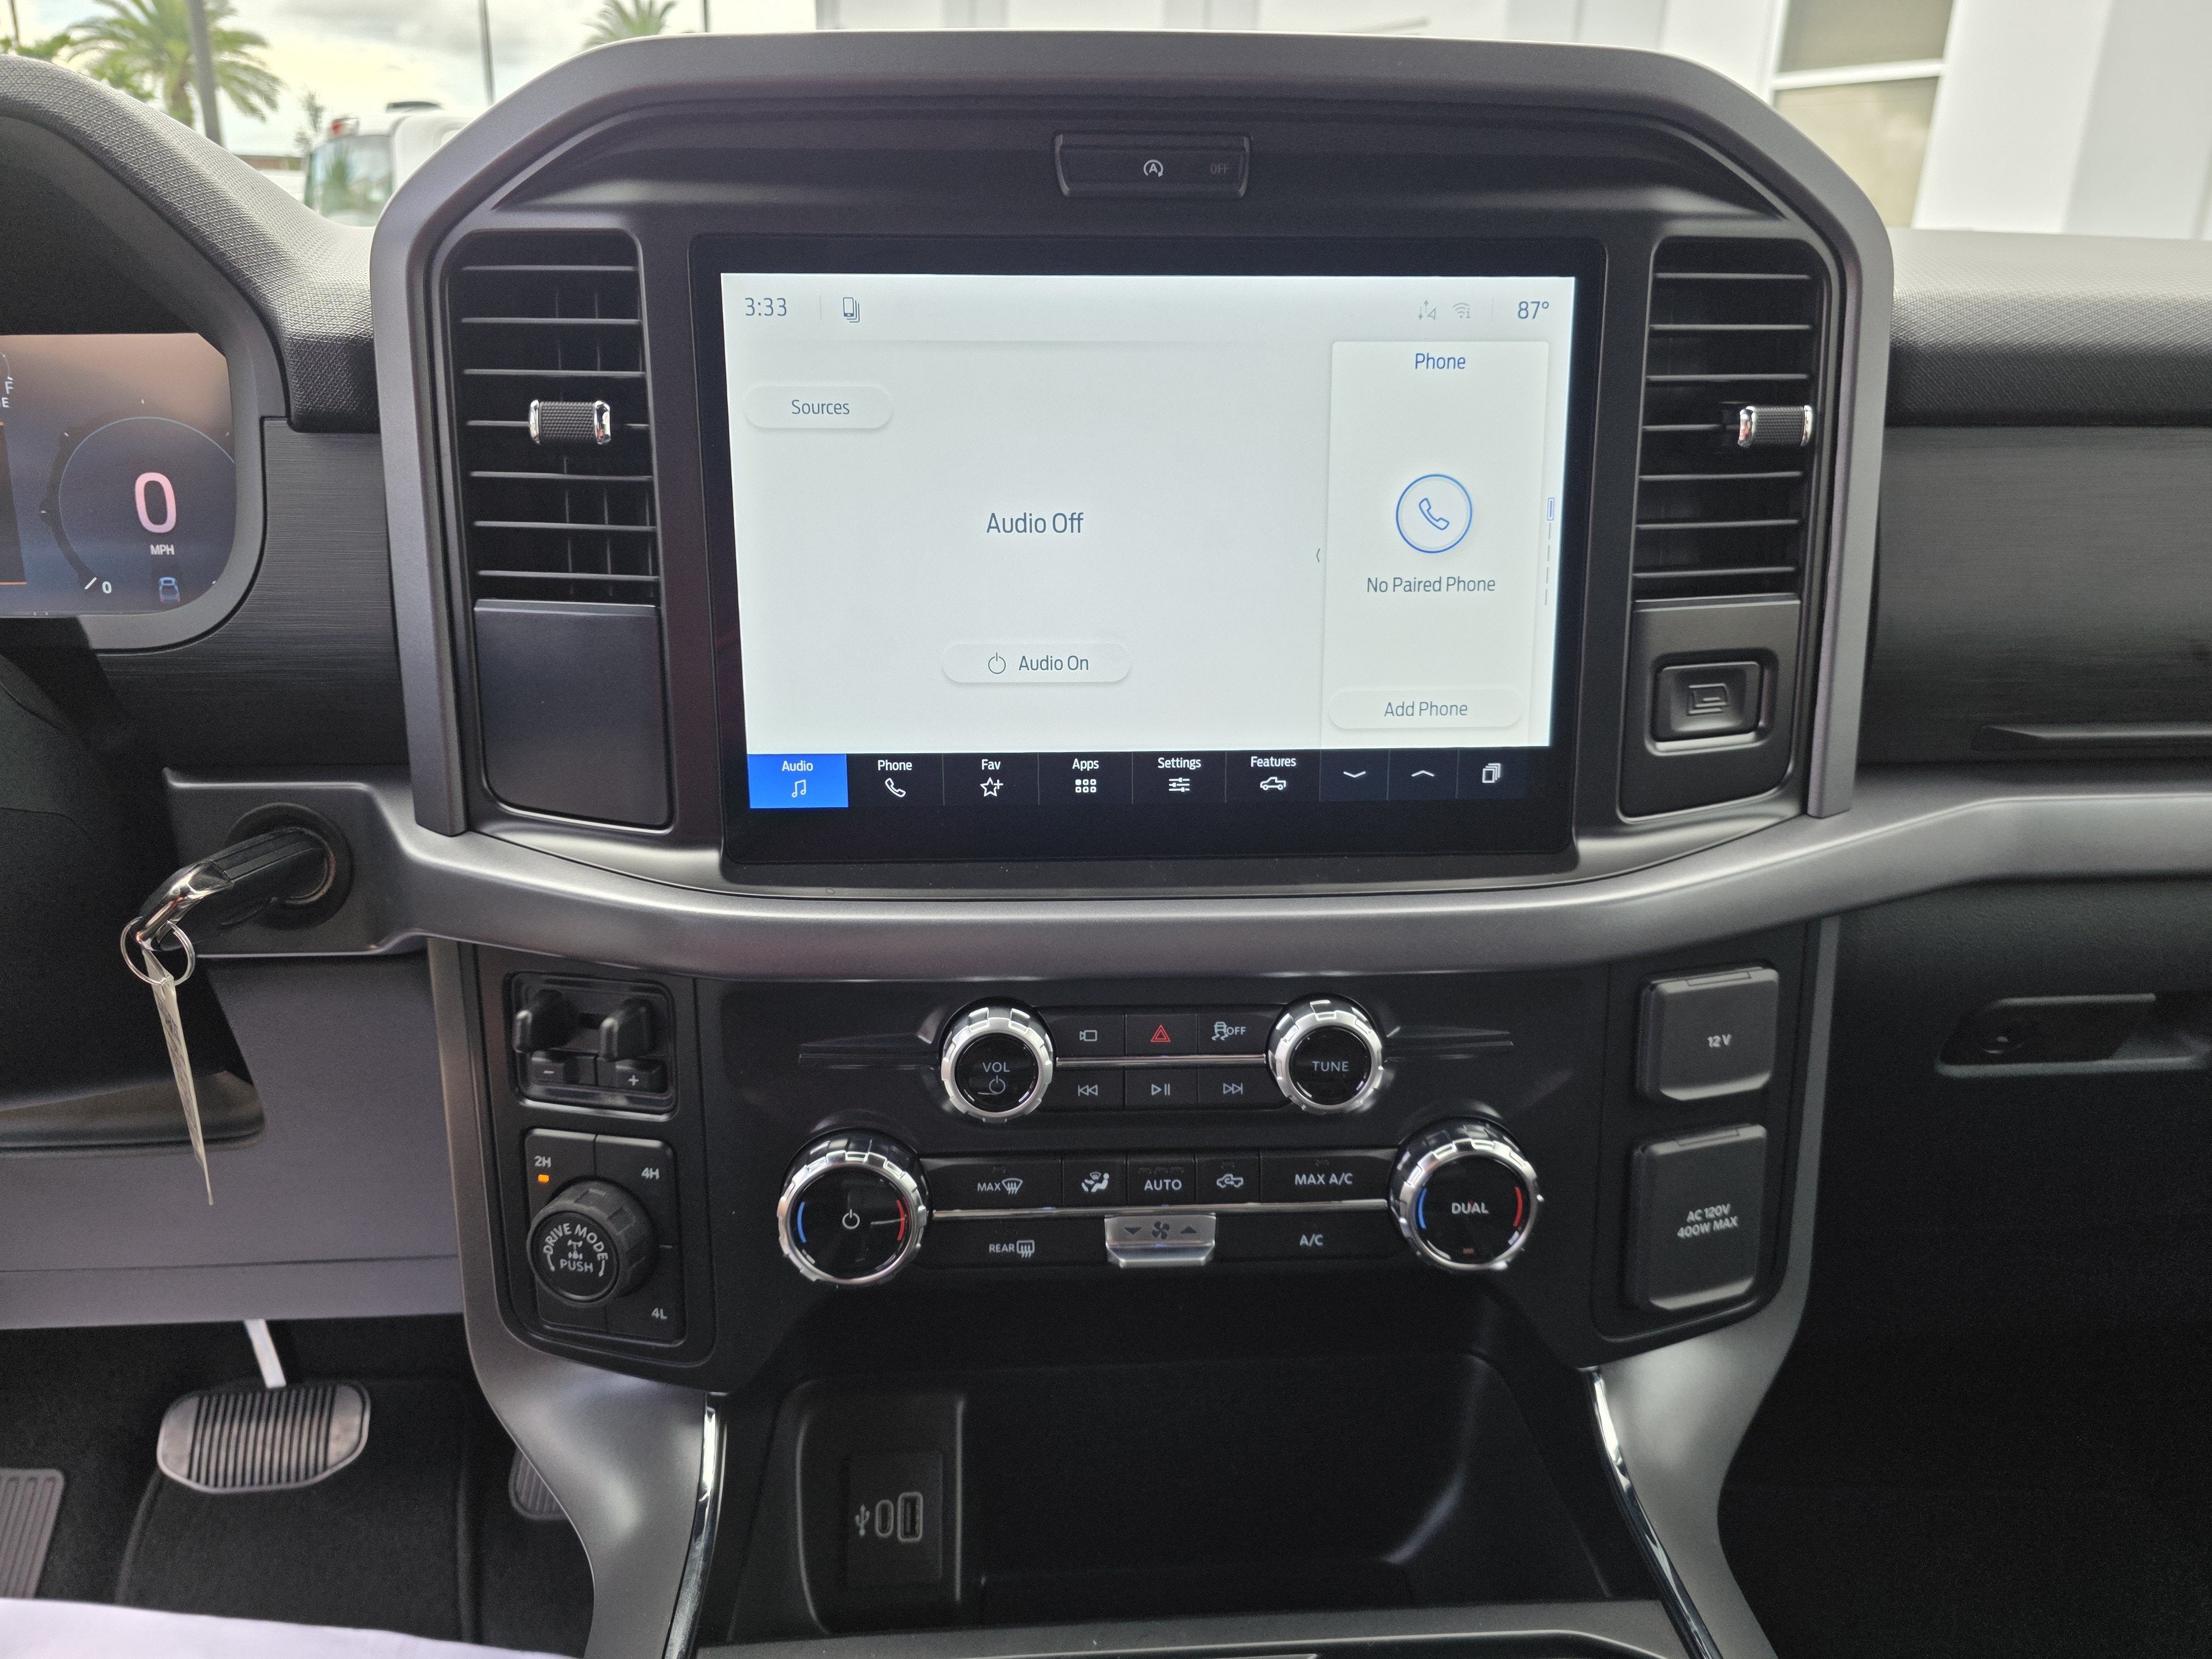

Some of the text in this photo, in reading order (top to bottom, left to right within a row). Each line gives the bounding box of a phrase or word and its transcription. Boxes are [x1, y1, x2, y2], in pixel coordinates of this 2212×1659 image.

[1209, 164, 1229, 175] OFF
[744, 297, 788, 317] 3:33
[1517, 301, 1550, 320] 87°
[1415, 352, 1466, 370] Phone
[5, 380, 13, 395] F
[2, 397, 9, 408] E
[791, 399, 850, 415] Sources
[134, 472, 176, 534] 0
[986, 512, 1084, 534] Audio Off
[150, 544, 175, 555] MPH
[1366, 576, 1496, 593] No Paired Phone
[1018, 655, 1089, 671] Audio On
[1384, 701, 1468, 717] Add Phone
[781, 760, 813, 773] Audio
[877, 759, 912, 771] Phone
[981, 759, 1001, 771] Fav
[1072, 758, 1099, 773] Apps
[1157, 757, 1201, 770] Settings
[1250, 755, 1297, 768] Features
[1225, 1025, 1246, 1036] OFF
[982, 1061, 1010, 1074] VOL
[1312, 1060, 1349, 1073] TUNE
[534, 1155, 551, 1168] 2H
[641, 1167, 660, 1180] 4H
[1295, 1172, 1353, 1186] MAX A/C
[977, 1182, 1001, 1192] MAX
[1144, 1179, 1182, 1191] AUTO
[1451, 1202, 1490, 1215] DUAL
[1687, 1203, 1731, 1223] AC 120V
[1677, 1215, 1739, 1239] 400W MAX
[542, 1223, 609, 1261] DRIVE MODE
[1299, 1234, 1324, 1248] A/C
[989, 1243, 1015, 1254] REAR
[559, 1258, 593, 1273] PUSH
[651, 1307, 668, 1321] 4L
